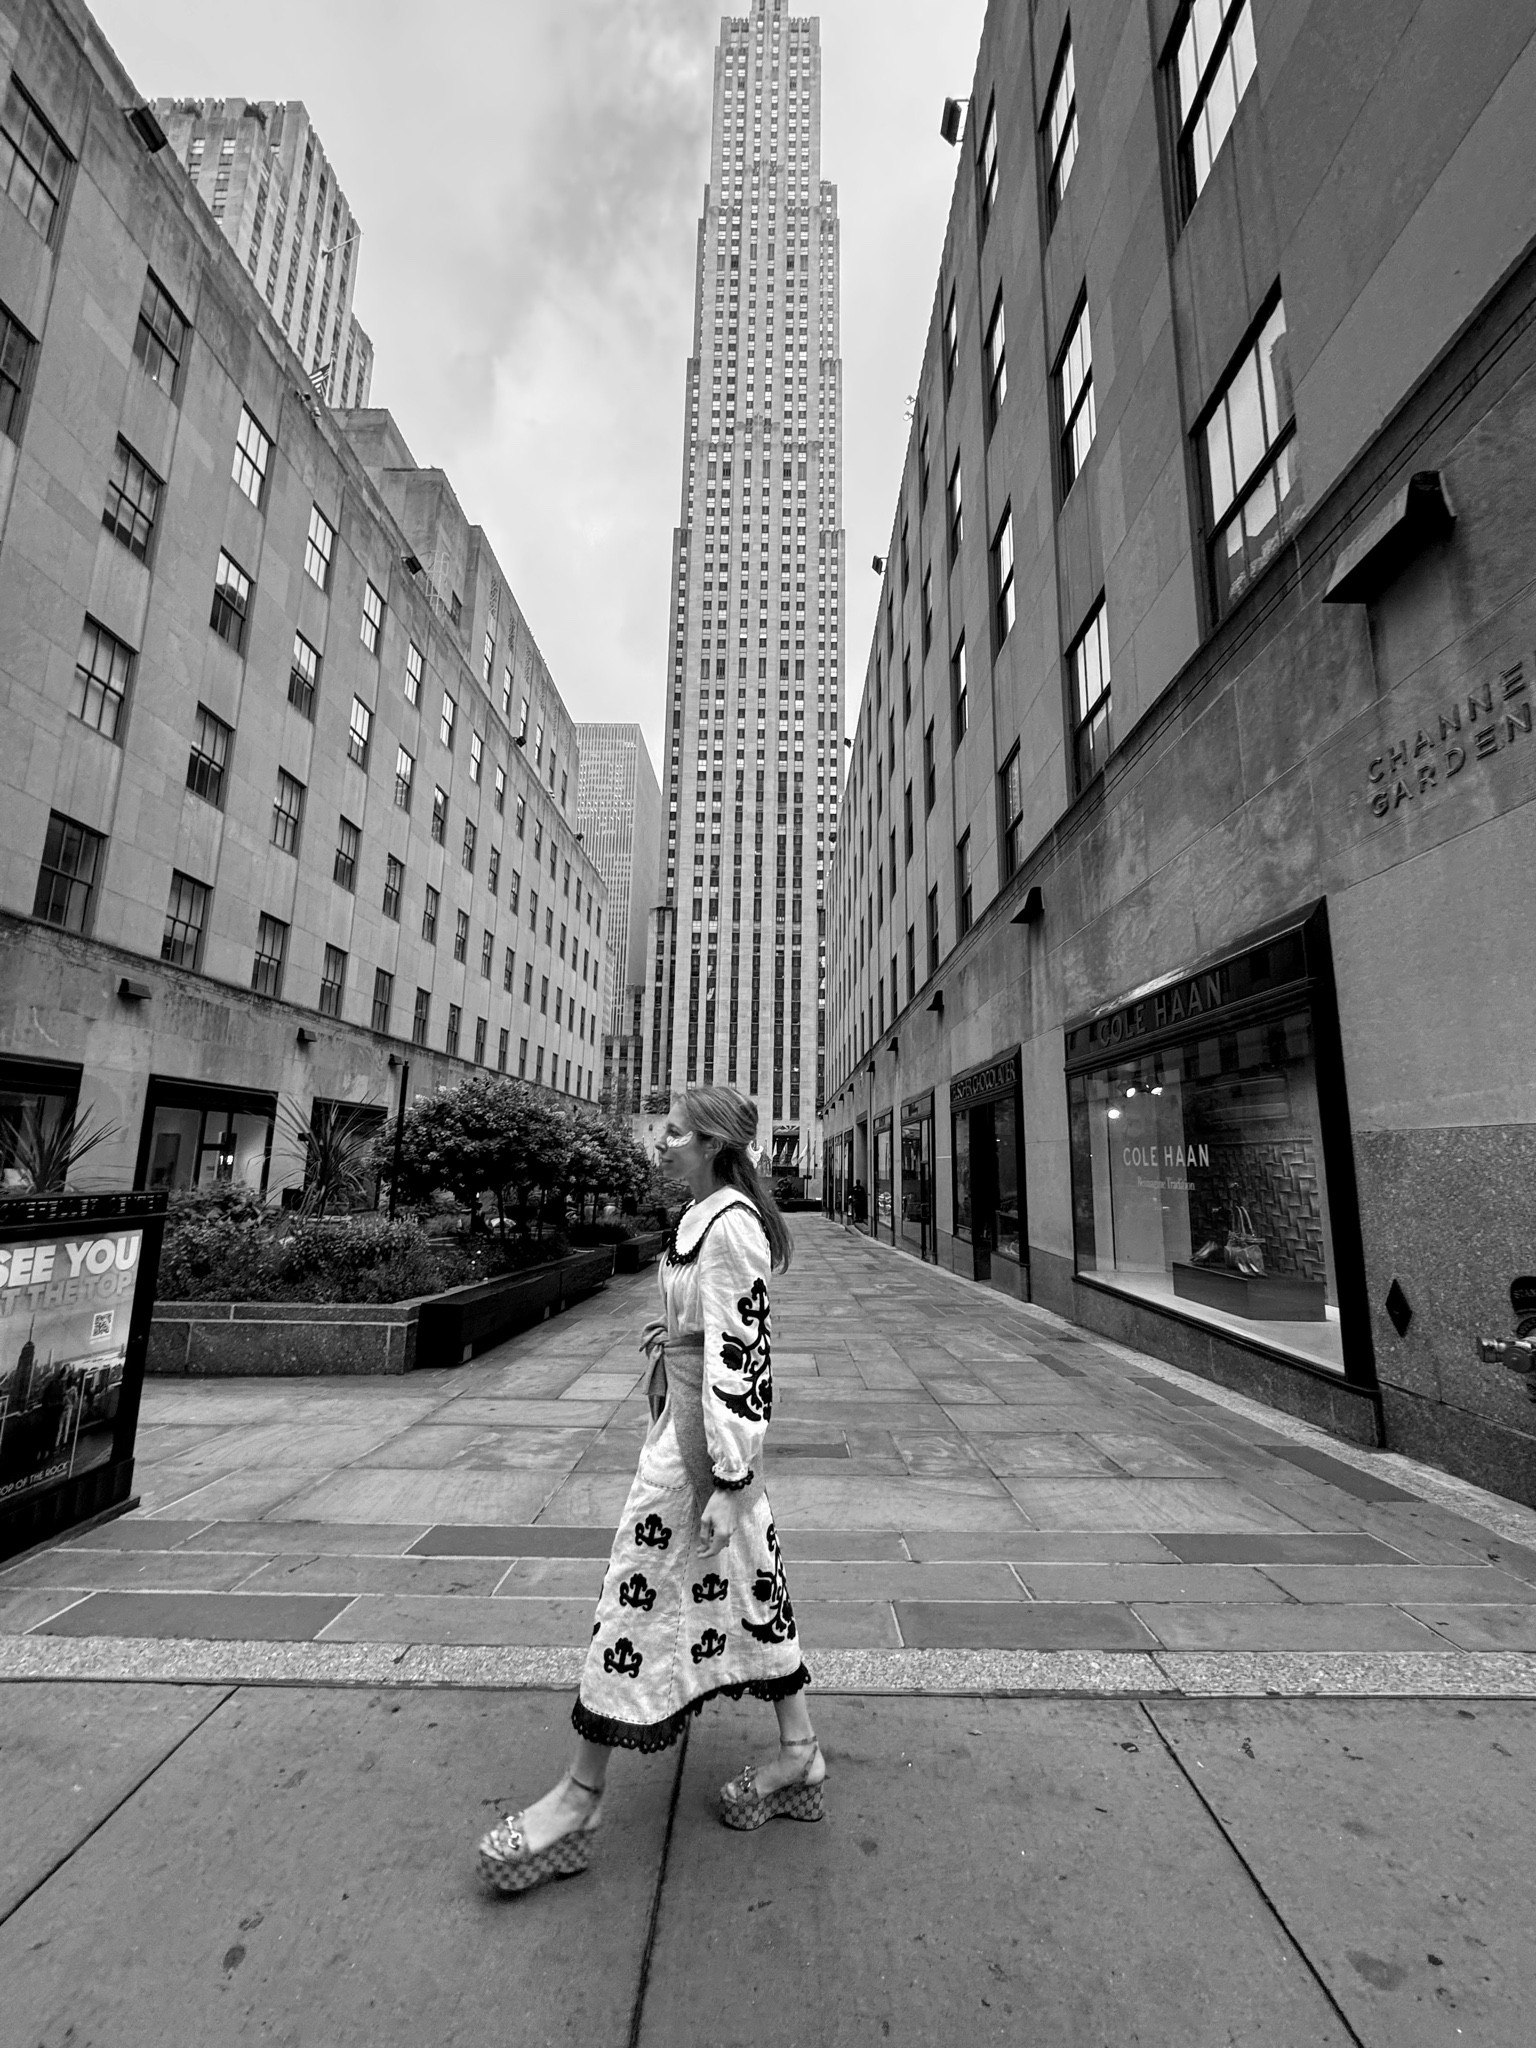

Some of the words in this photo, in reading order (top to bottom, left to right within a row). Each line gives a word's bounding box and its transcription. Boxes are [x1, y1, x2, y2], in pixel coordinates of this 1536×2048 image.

[1368, 650, 1536, 784] CHANNE
[1371, 702, 1532, 817] GARDEN
[1099, 1003, 1147, 1047] COLE
[1155, 970, 1222, 1027] HAAN
[1123, 1146, 1158, 1166] COLE
[1164, 1144, 1210, 1167] HAAN
[65, 1235, 140, 1278] YOU
[27, 1276, 79, 1313] THE
[83, 1271, 133, 1300] TOP
[15, 1475, 28, 1490] OF
[29, 1469, 44, 1484] THE
